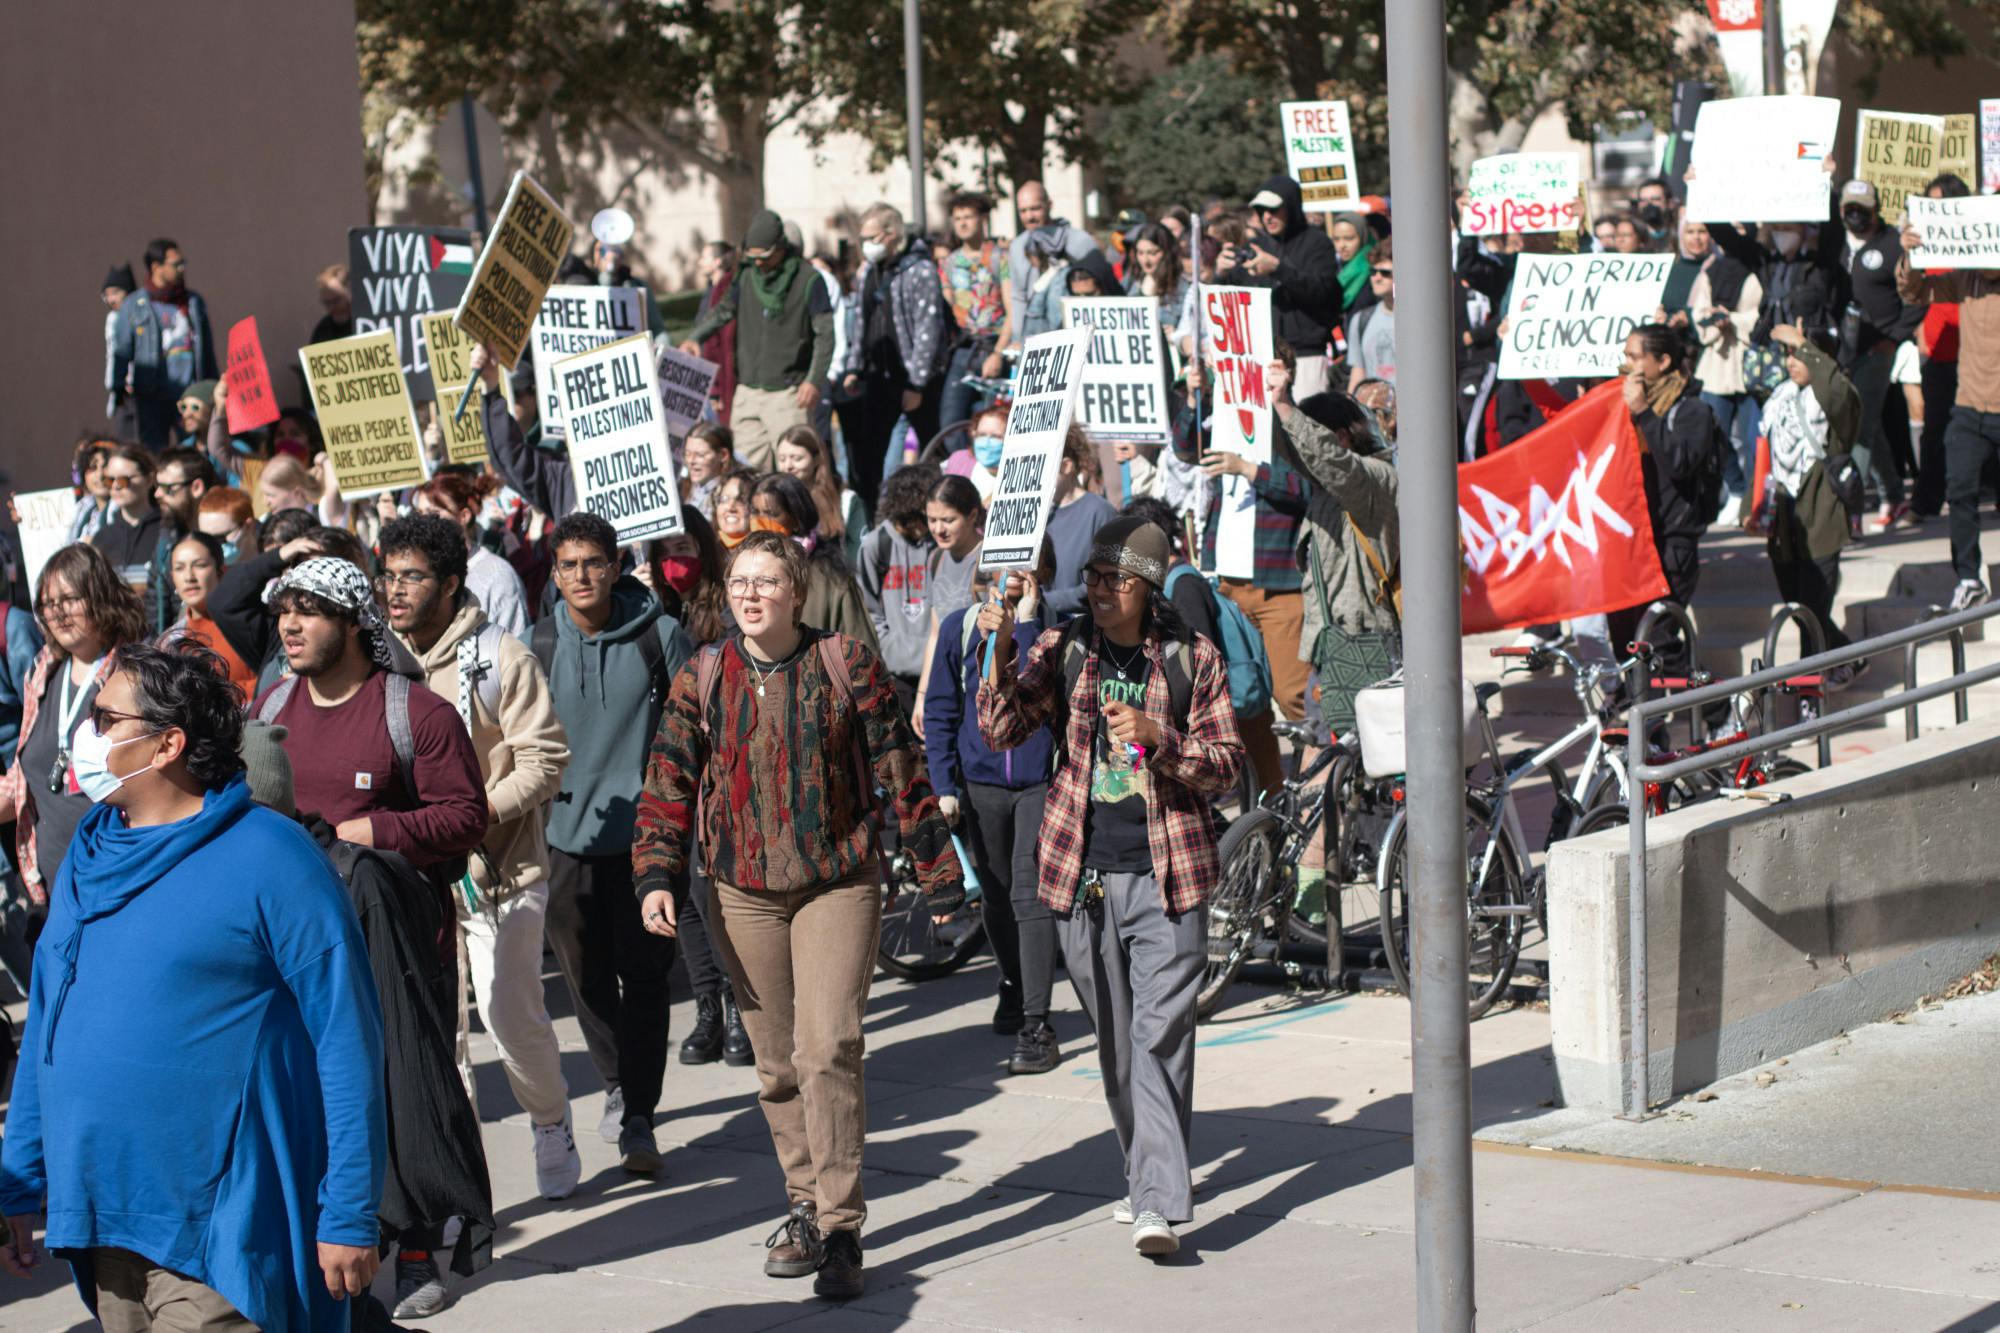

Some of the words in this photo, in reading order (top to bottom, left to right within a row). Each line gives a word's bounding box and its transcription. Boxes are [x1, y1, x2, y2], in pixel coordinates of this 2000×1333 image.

[1293, 109, 1338, 133] FREE
[1869, 119, 1900, 142] END
[1906, 122, 1932, 144] ALL
[1291, 137, 1345, 152] PALESTINE
[1867, 143, 1897, 166] U.S.
[1904, 147, 1932, 167] AID
[511, 189, 548, 239] FREE
[540, 215, 569, 261] ALL
[1920, 201, 1964, 216] FREE
[1927, 222, 2000, 241] PALESTI
[497, 221, 554, 288] PALESTINIAN
[486, 261, 535, 319] POLITICAL
[1526, 261, 1573, 288] NO
[1585, 259, 1668, 283] PRIDE
[362, 272, 434, 316] VIVA
[1565, 285, 1602, 312] IN
[539, 297, 589, 329] FREE
[596, 300, 635, 331] ALL
[1072, 307, 1150, 330] PALESTINE
[1207, 291, 1252, 355] SHUT
[429, 319, 459, 350] END
[1128, 335, 1154, 364] BE
[309, 344, 395, 379] RESISTANCE
[436, 350, 467, 383] U.S.
[657, 358, 712, 395] RESISTANCE
[1019, 348, 1048, 397] FREE
[1045, 344, 1074, 393] ALL
[317, 384, 331, 407] IS
[335, 372, 401, 404] JUSTIFIED
[563, 363, 610, 411] FREE
[611, 352, 648, 397] ALL
[1216, 357, 1238, 404] IT
[1238, 357, 1267, 410] DOWN
[571, 396, 654, 443] PALESTINIAN
[1009, 399, 1064, 436] PALESTINIAN
[1083, 383, 1157, 424] FREE!
[328, 421, 363, 446] WHEN
[365, 416, 410, 444] PEOPLE
[334, 447, 355, 469] ARE
[357, 442, 416, 466] OCCUPIED!
[584, 443, 658, 491] POLITICAL
[998, 453, 1046, 495] POLITICAL
[586, 476, 669, 522] PRISONERS
[987, 496, 1041, 537] PRISONERS
